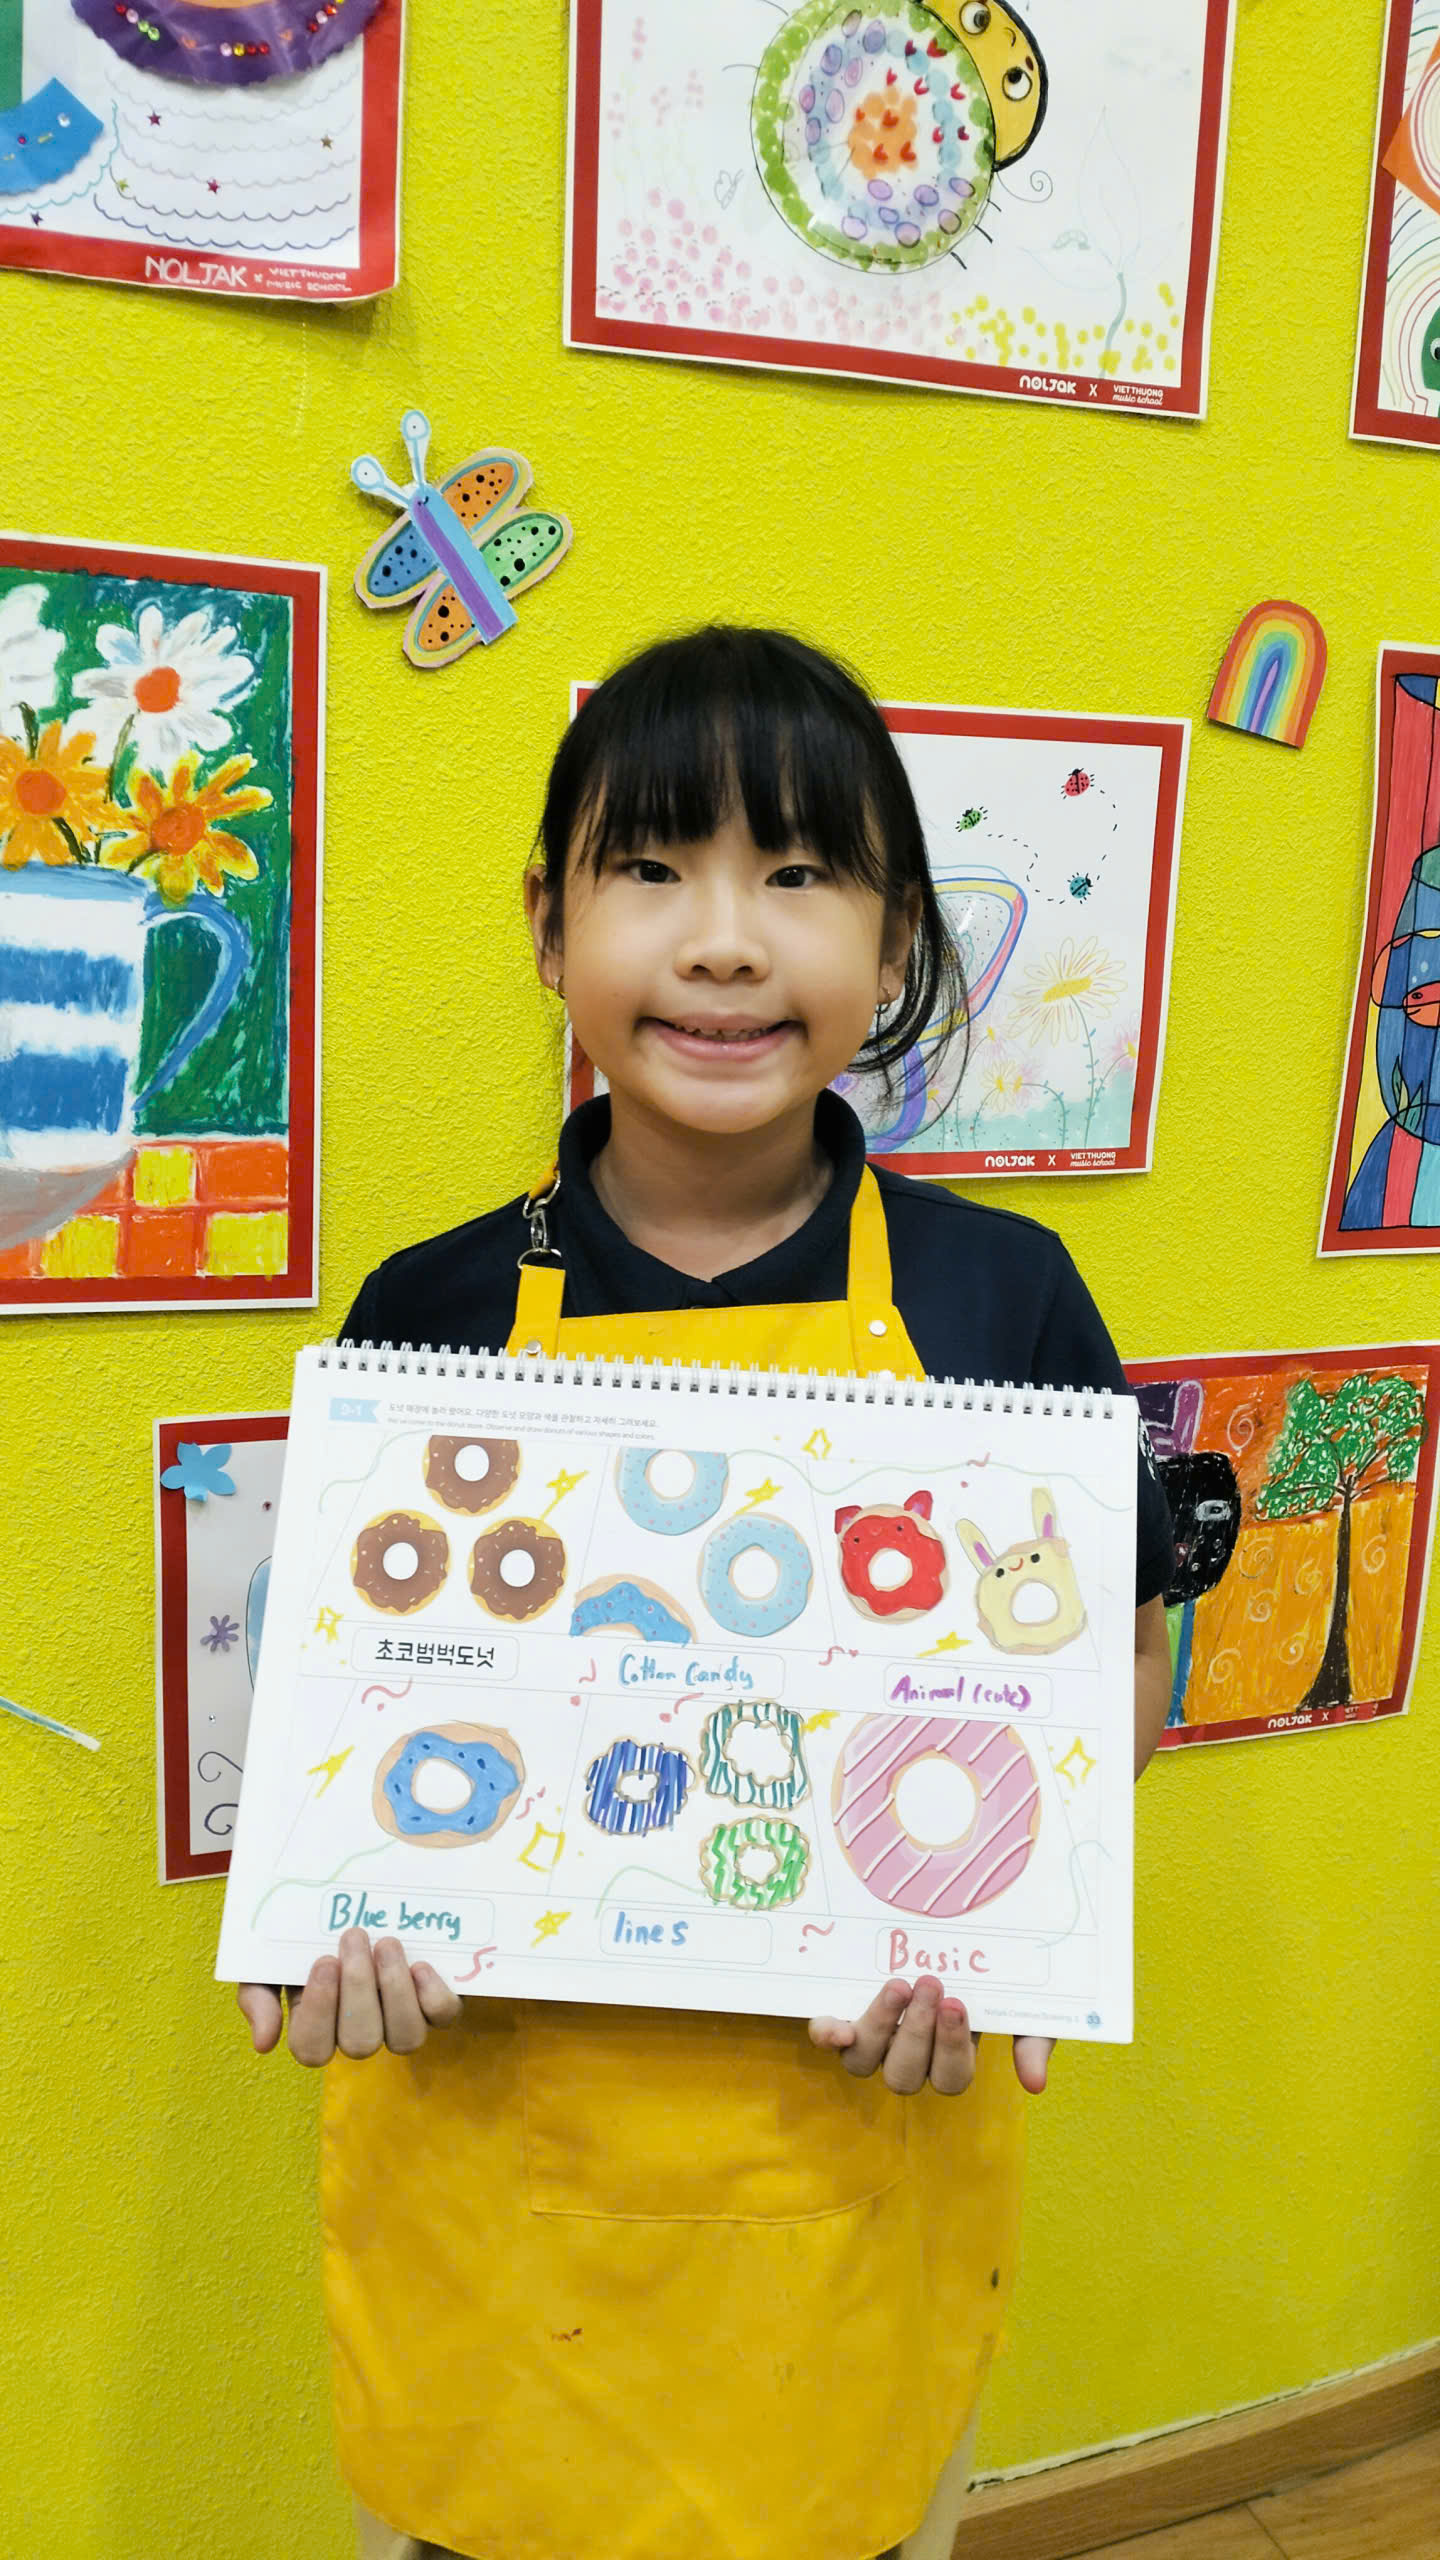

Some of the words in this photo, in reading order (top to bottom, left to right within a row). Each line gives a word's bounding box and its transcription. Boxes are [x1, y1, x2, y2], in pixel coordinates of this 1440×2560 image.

[145, 255, 248, 288] NOLJAK
[307, 281, 352, 292] SCHOOL
[375, 1638, 495, 1669] 초코범벅도넛
[685, 1656, 754, 1690] Candy
[890, 1674, 965, 1704] Animal
[398, 1901, 461, 1941] berry
[613, 1911, 689, 1946] lines
[889, 1928, 990, 1974] Basic
[1087, 2015, 1101, 2025] 33
